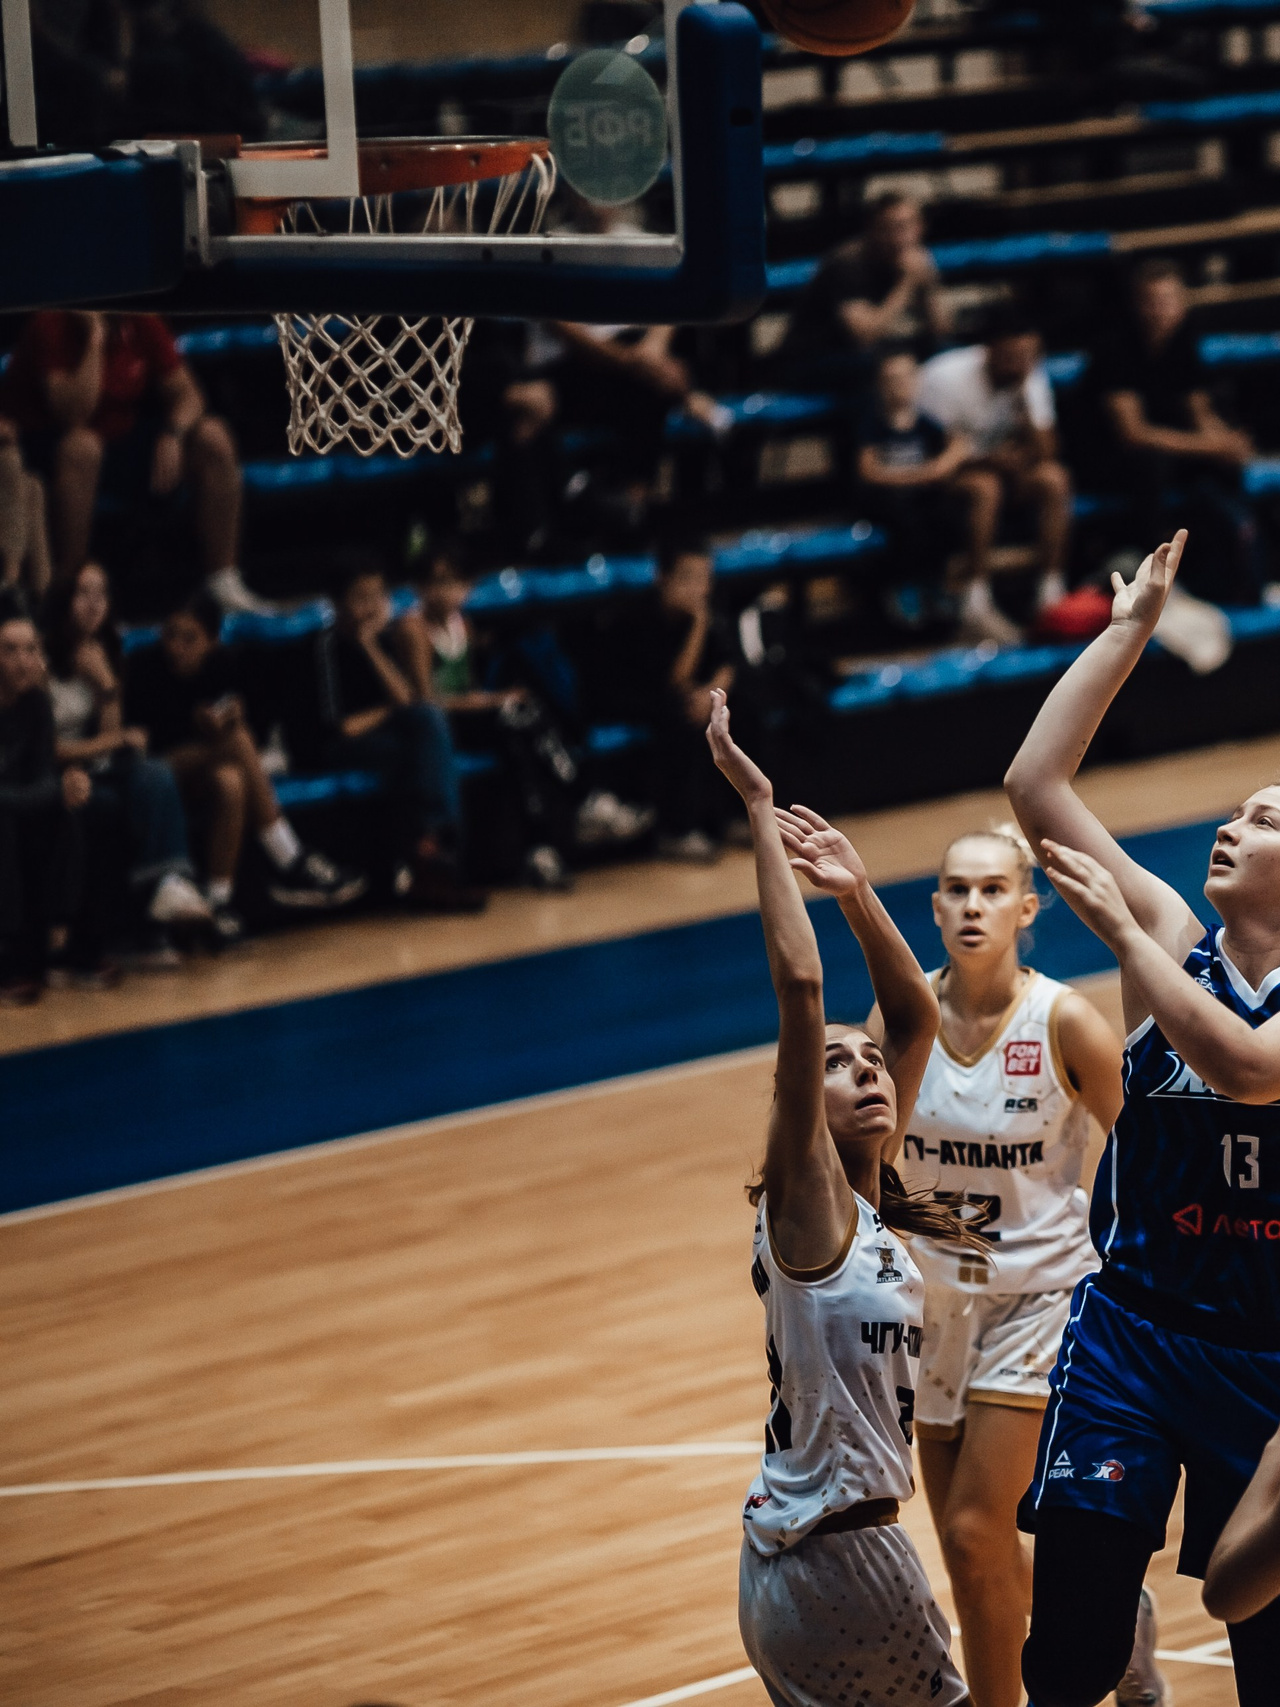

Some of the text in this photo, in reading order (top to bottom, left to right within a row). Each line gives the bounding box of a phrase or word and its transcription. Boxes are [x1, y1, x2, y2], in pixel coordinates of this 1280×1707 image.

[1194, 977, 1218, 997] PEA
[1008, 1044, 1040, 1058] FON
[1007, 1058, 1038, 1072] BET
[1220, 1134, 1260, 1189] 13
[1048, 1467, 1076, 1480] PEAK
